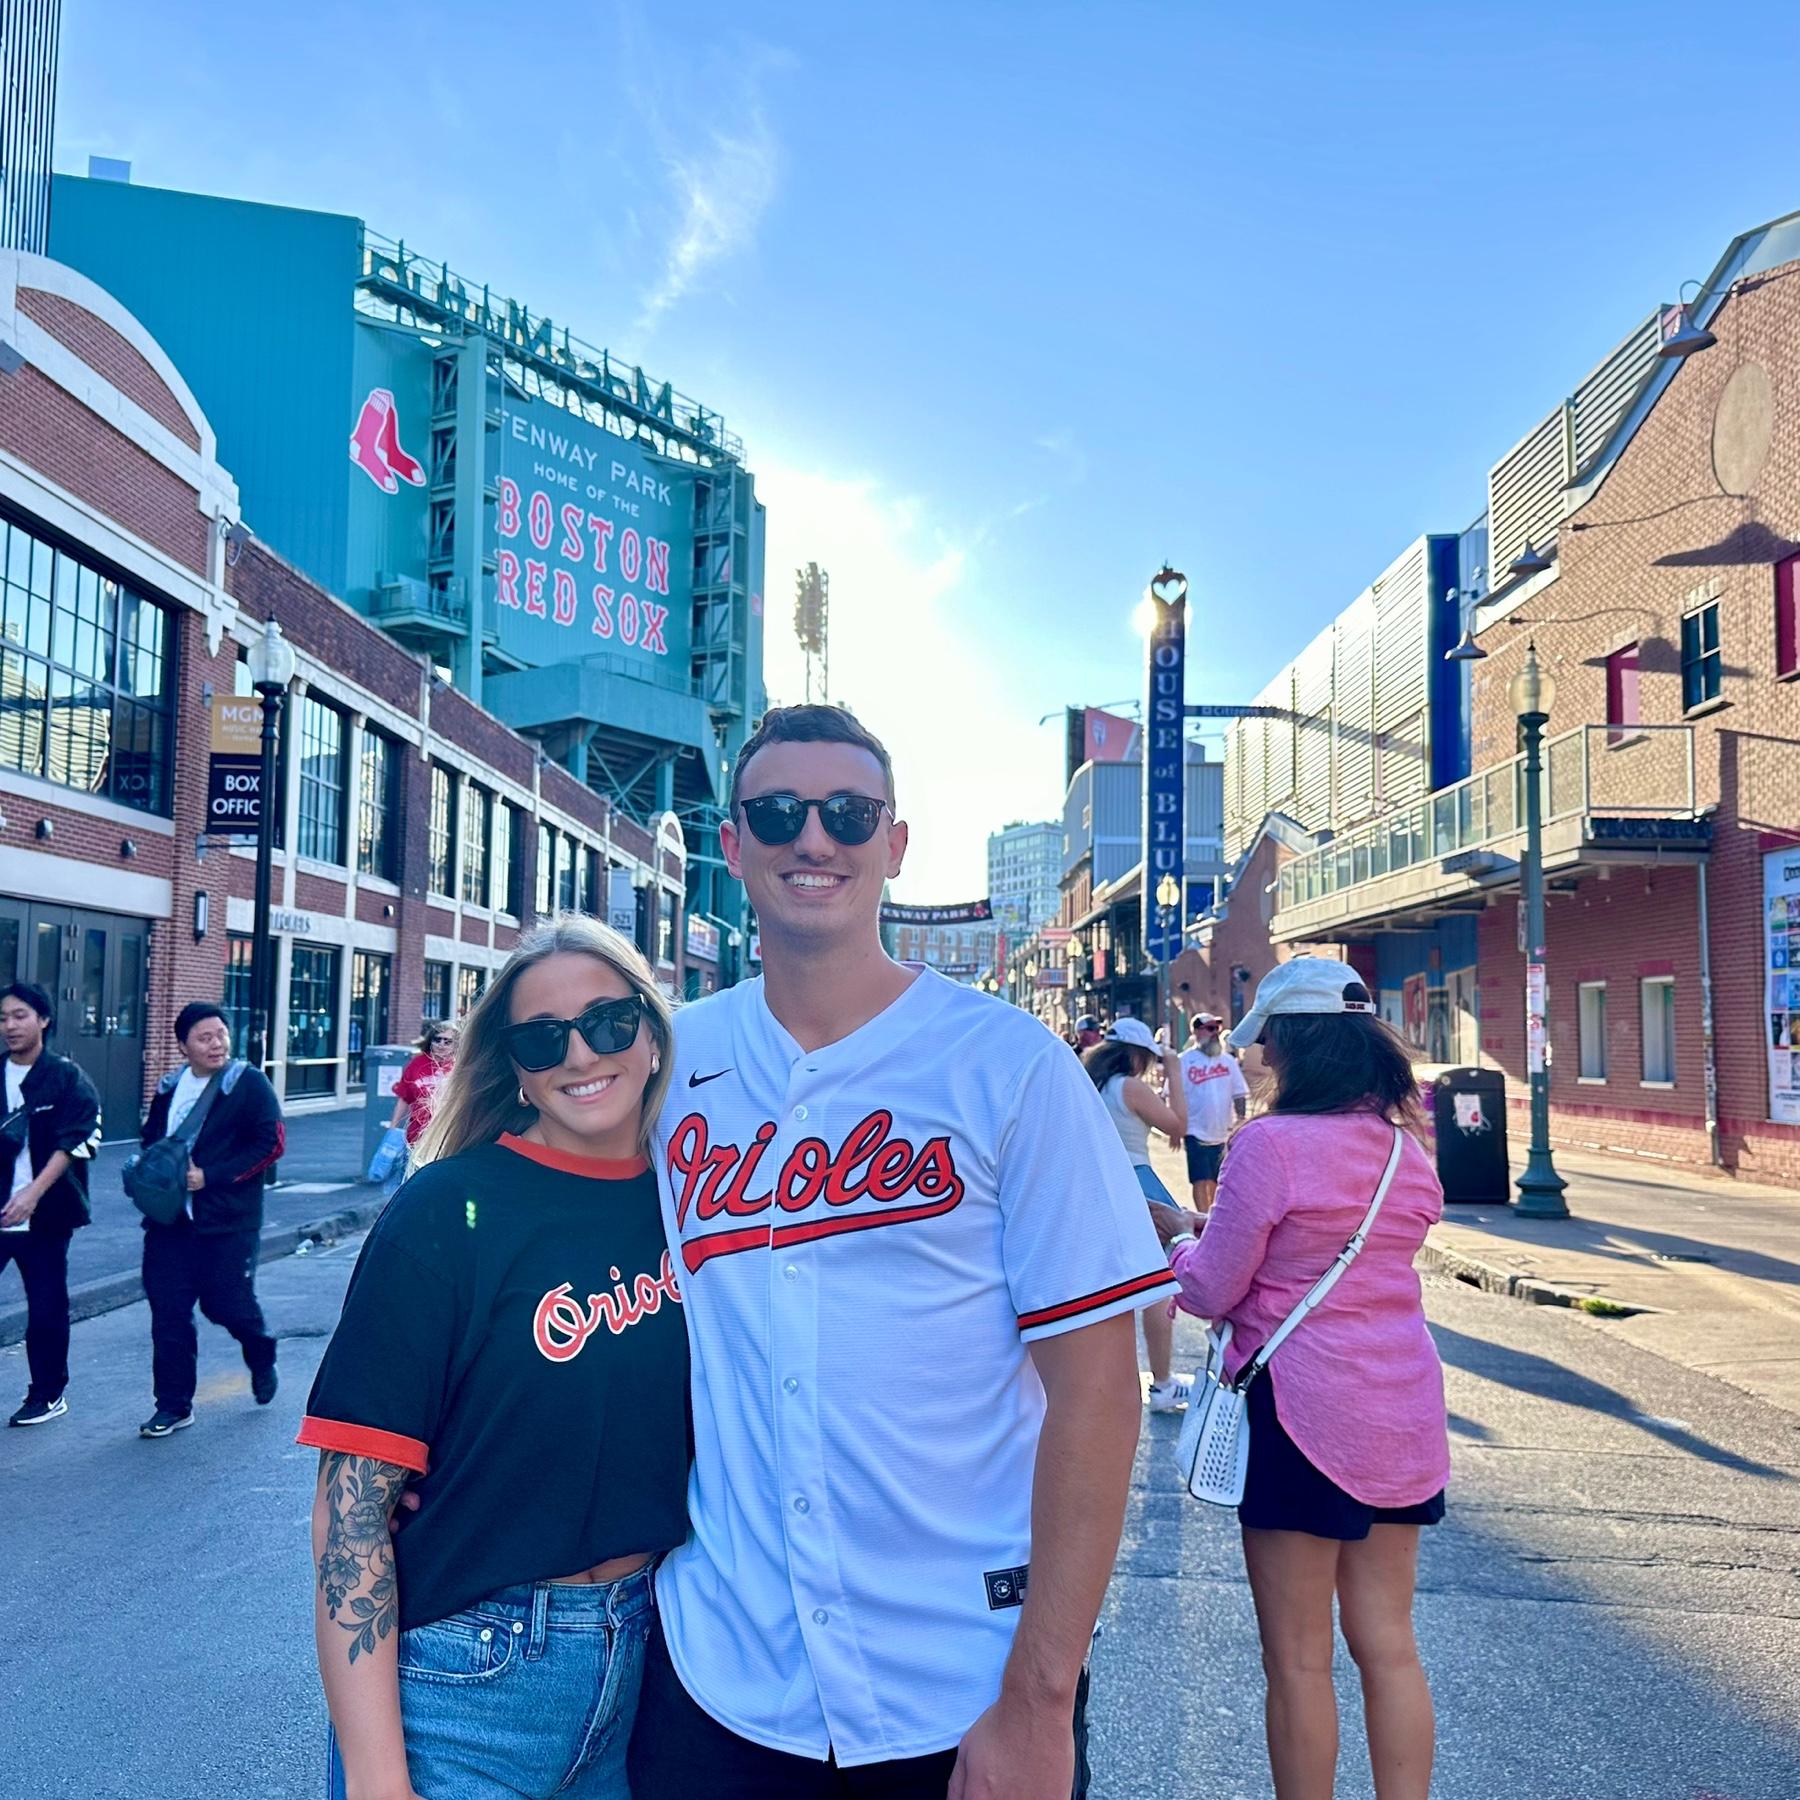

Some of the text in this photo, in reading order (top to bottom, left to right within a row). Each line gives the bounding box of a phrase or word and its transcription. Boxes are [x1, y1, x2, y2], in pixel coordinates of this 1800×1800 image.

[534, 462, 640, 517] HOME OF THE
[611, 461, 671, 506] PARK
[495, 475, 670, 595] BOSTON
[494, 549, 669, 655] RED SOX
[225, 775, 260, 792] BOX
[1154, 763, 1178, 779] of
[212, 798, 260, 816] OFFIC
[1154, 793, 1178, 927] BLU
[882, 908, 969, 921] ENWAY PARK
[667, 1109, 964, 1236] Orioles
[533, 1249, 682, 1363] Oriol
